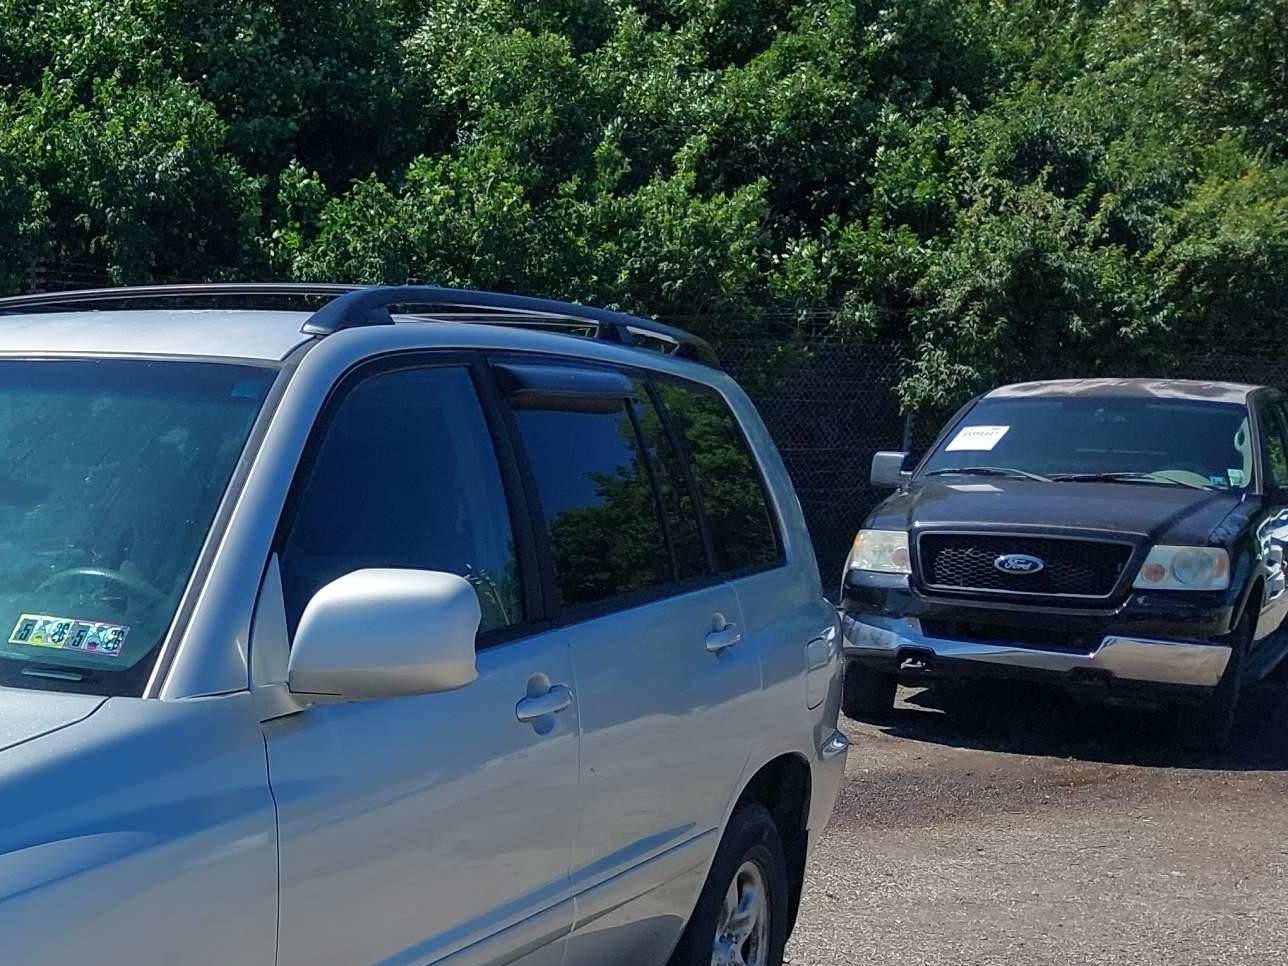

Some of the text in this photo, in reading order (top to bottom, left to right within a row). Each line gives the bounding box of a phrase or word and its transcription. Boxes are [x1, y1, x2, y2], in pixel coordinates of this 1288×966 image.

[1004, 559, 1032, 570] Ford
[19, 623, 33, 640] 5
[72, 629, 88, 647] 5
